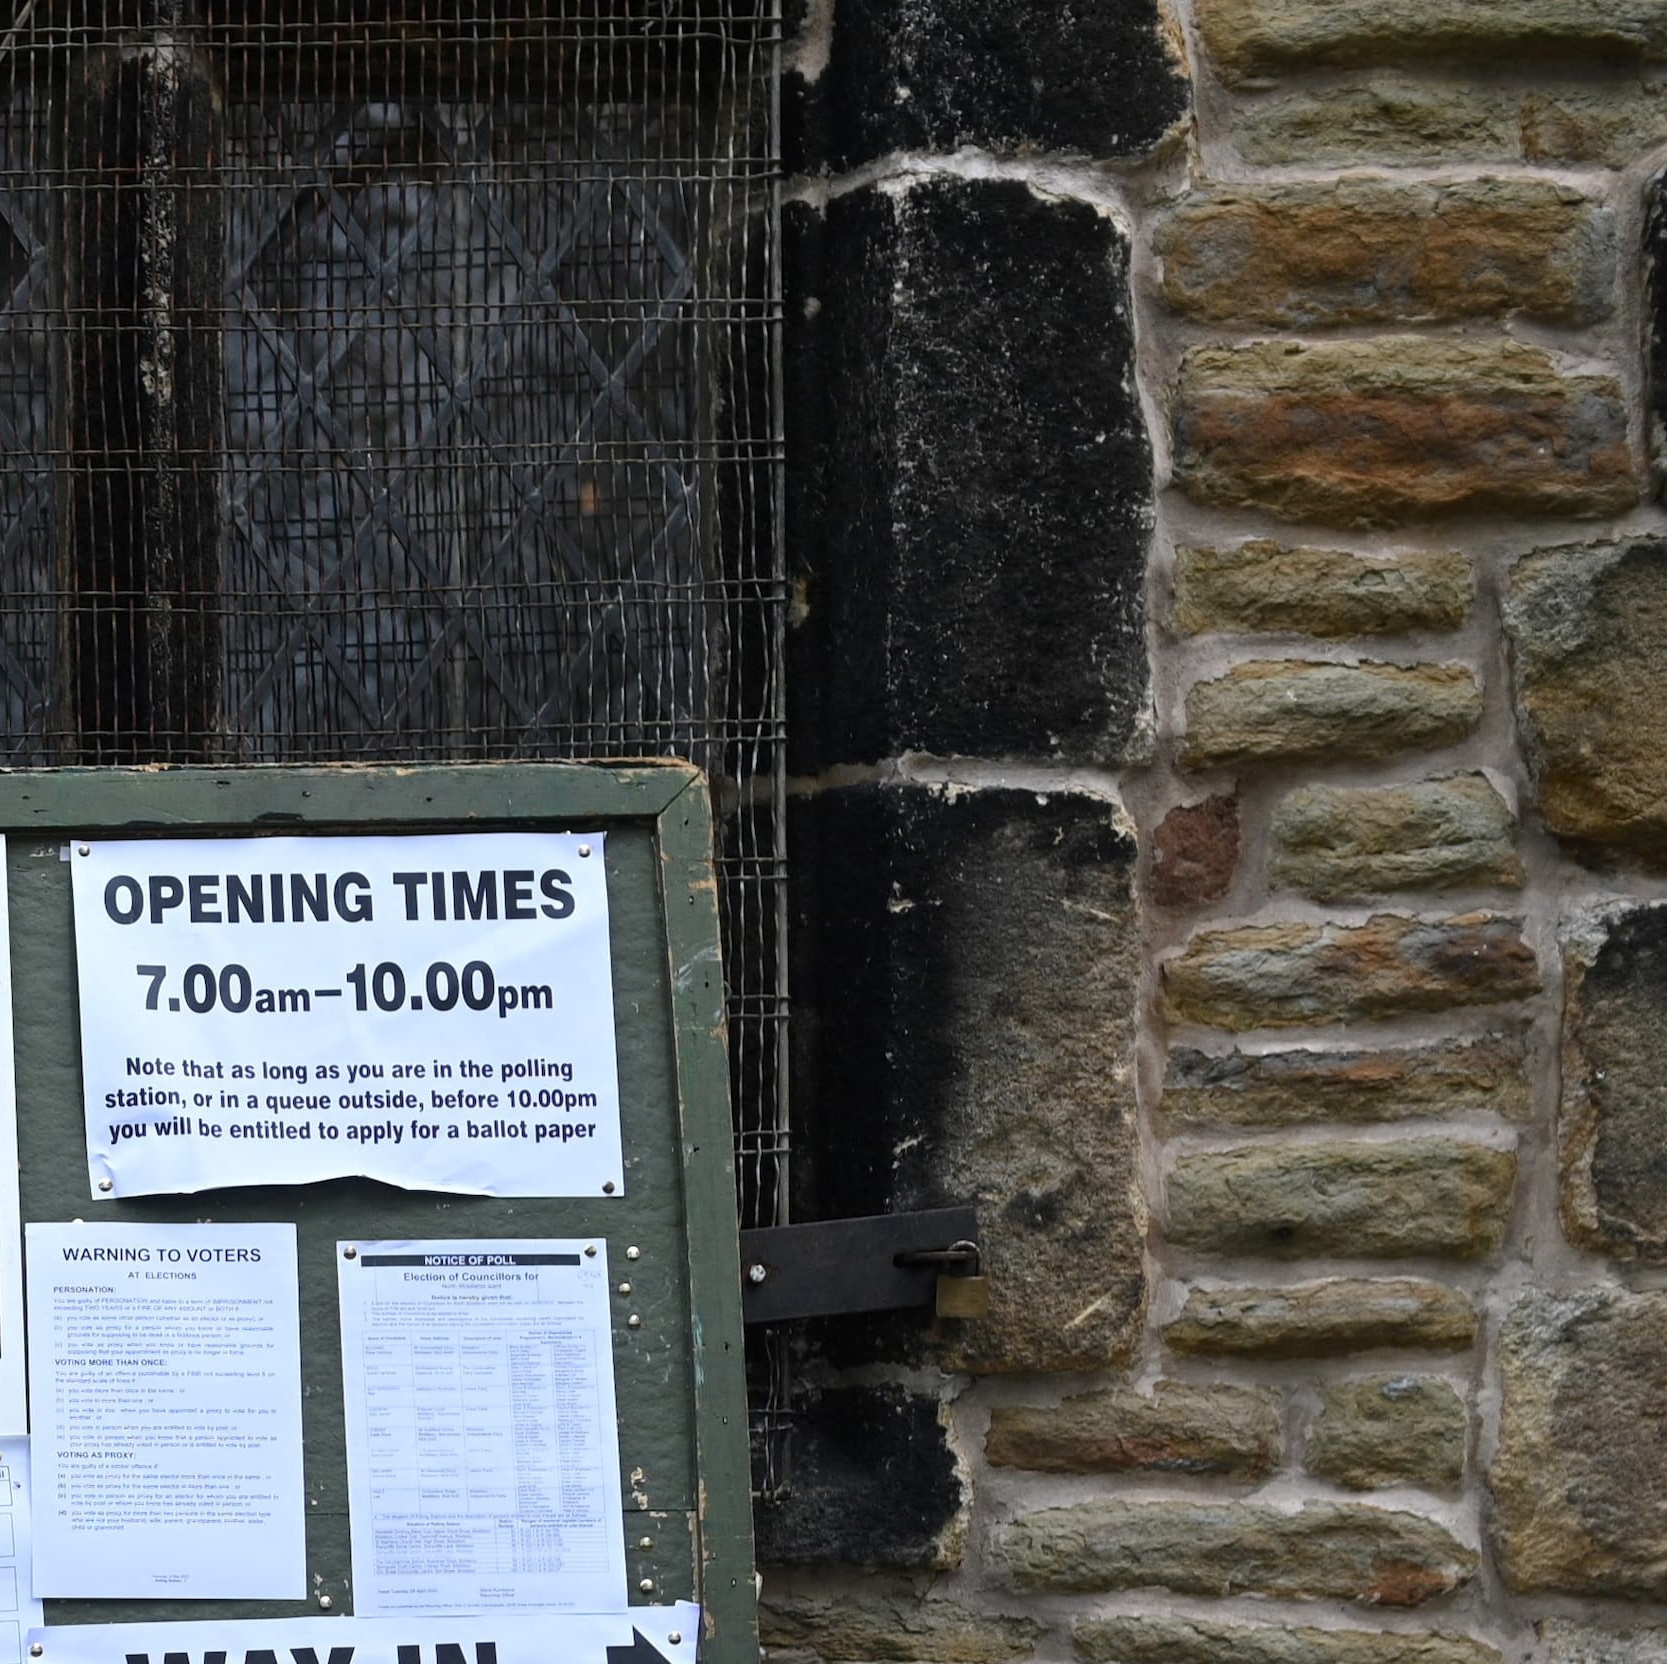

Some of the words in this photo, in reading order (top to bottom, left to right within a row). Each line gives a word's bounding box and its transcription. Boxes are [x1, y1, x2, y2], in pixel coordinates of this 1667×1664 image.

[104, 871, 373, 924] OPENING
[392, 868, 575, 920] TIMES
[126, 1056, 175, 1075] Note
[181, 1059, 224, 1078] that
[231, 1064, 255, 1079] as
[262, 1061, 307, 1082] long
[315, 1064, 339, 1079] as
[346, 1064, 384, 1083] you
[391, 1064, 425, 1078] are
[433, 1059, 452, 1078] in
[459, 1059, 493, 1078] the
[501, 1058, 572, 1083] polling
[105, 1086, 186, 1108] station,
[193, 1093, 212, 1107] or
[220, 1090, 239, 1108] in
[246, 1094, 258, 1108] a
[266, 1095, 331, 1112] queue
[338, 1089, 424, 1112] outside,
[431, 1089, 498, 1108] before
[507, 1088, 597, 1112] 10.00pm
[108, 1122, 146, 1144] you
[154, 1116, 191, 1136] will
[198, 1118, 222, 1138] be
[229, 1120, 310, 1139] entitled
[318, 1121, 338, 1139] to
[346, 1120, 403, 1144] apply
[410, 1119, 439, 1139] for
[447, 1124, 459, 1138] a
[466, 1119, 527, 1138] ballot
[534, 1123, 596, 1143] paper
[62, 1247, 150, 1261] WARNING
[156, 1248, 180, 1262] TO
[186, 1248, 261, 1262] VOTERS
[425, 1255, 465, 1265] NOTICE
[468, 1255, 483, 1264] OF
[487, 1255, 516, 1265] POLL
[403, 1272, 445, 1281] Election
[448, 1272, 458, 1281] of
[461, 1272, 521, 1281] Councillors
[524, 1272, 539, 1280] for
